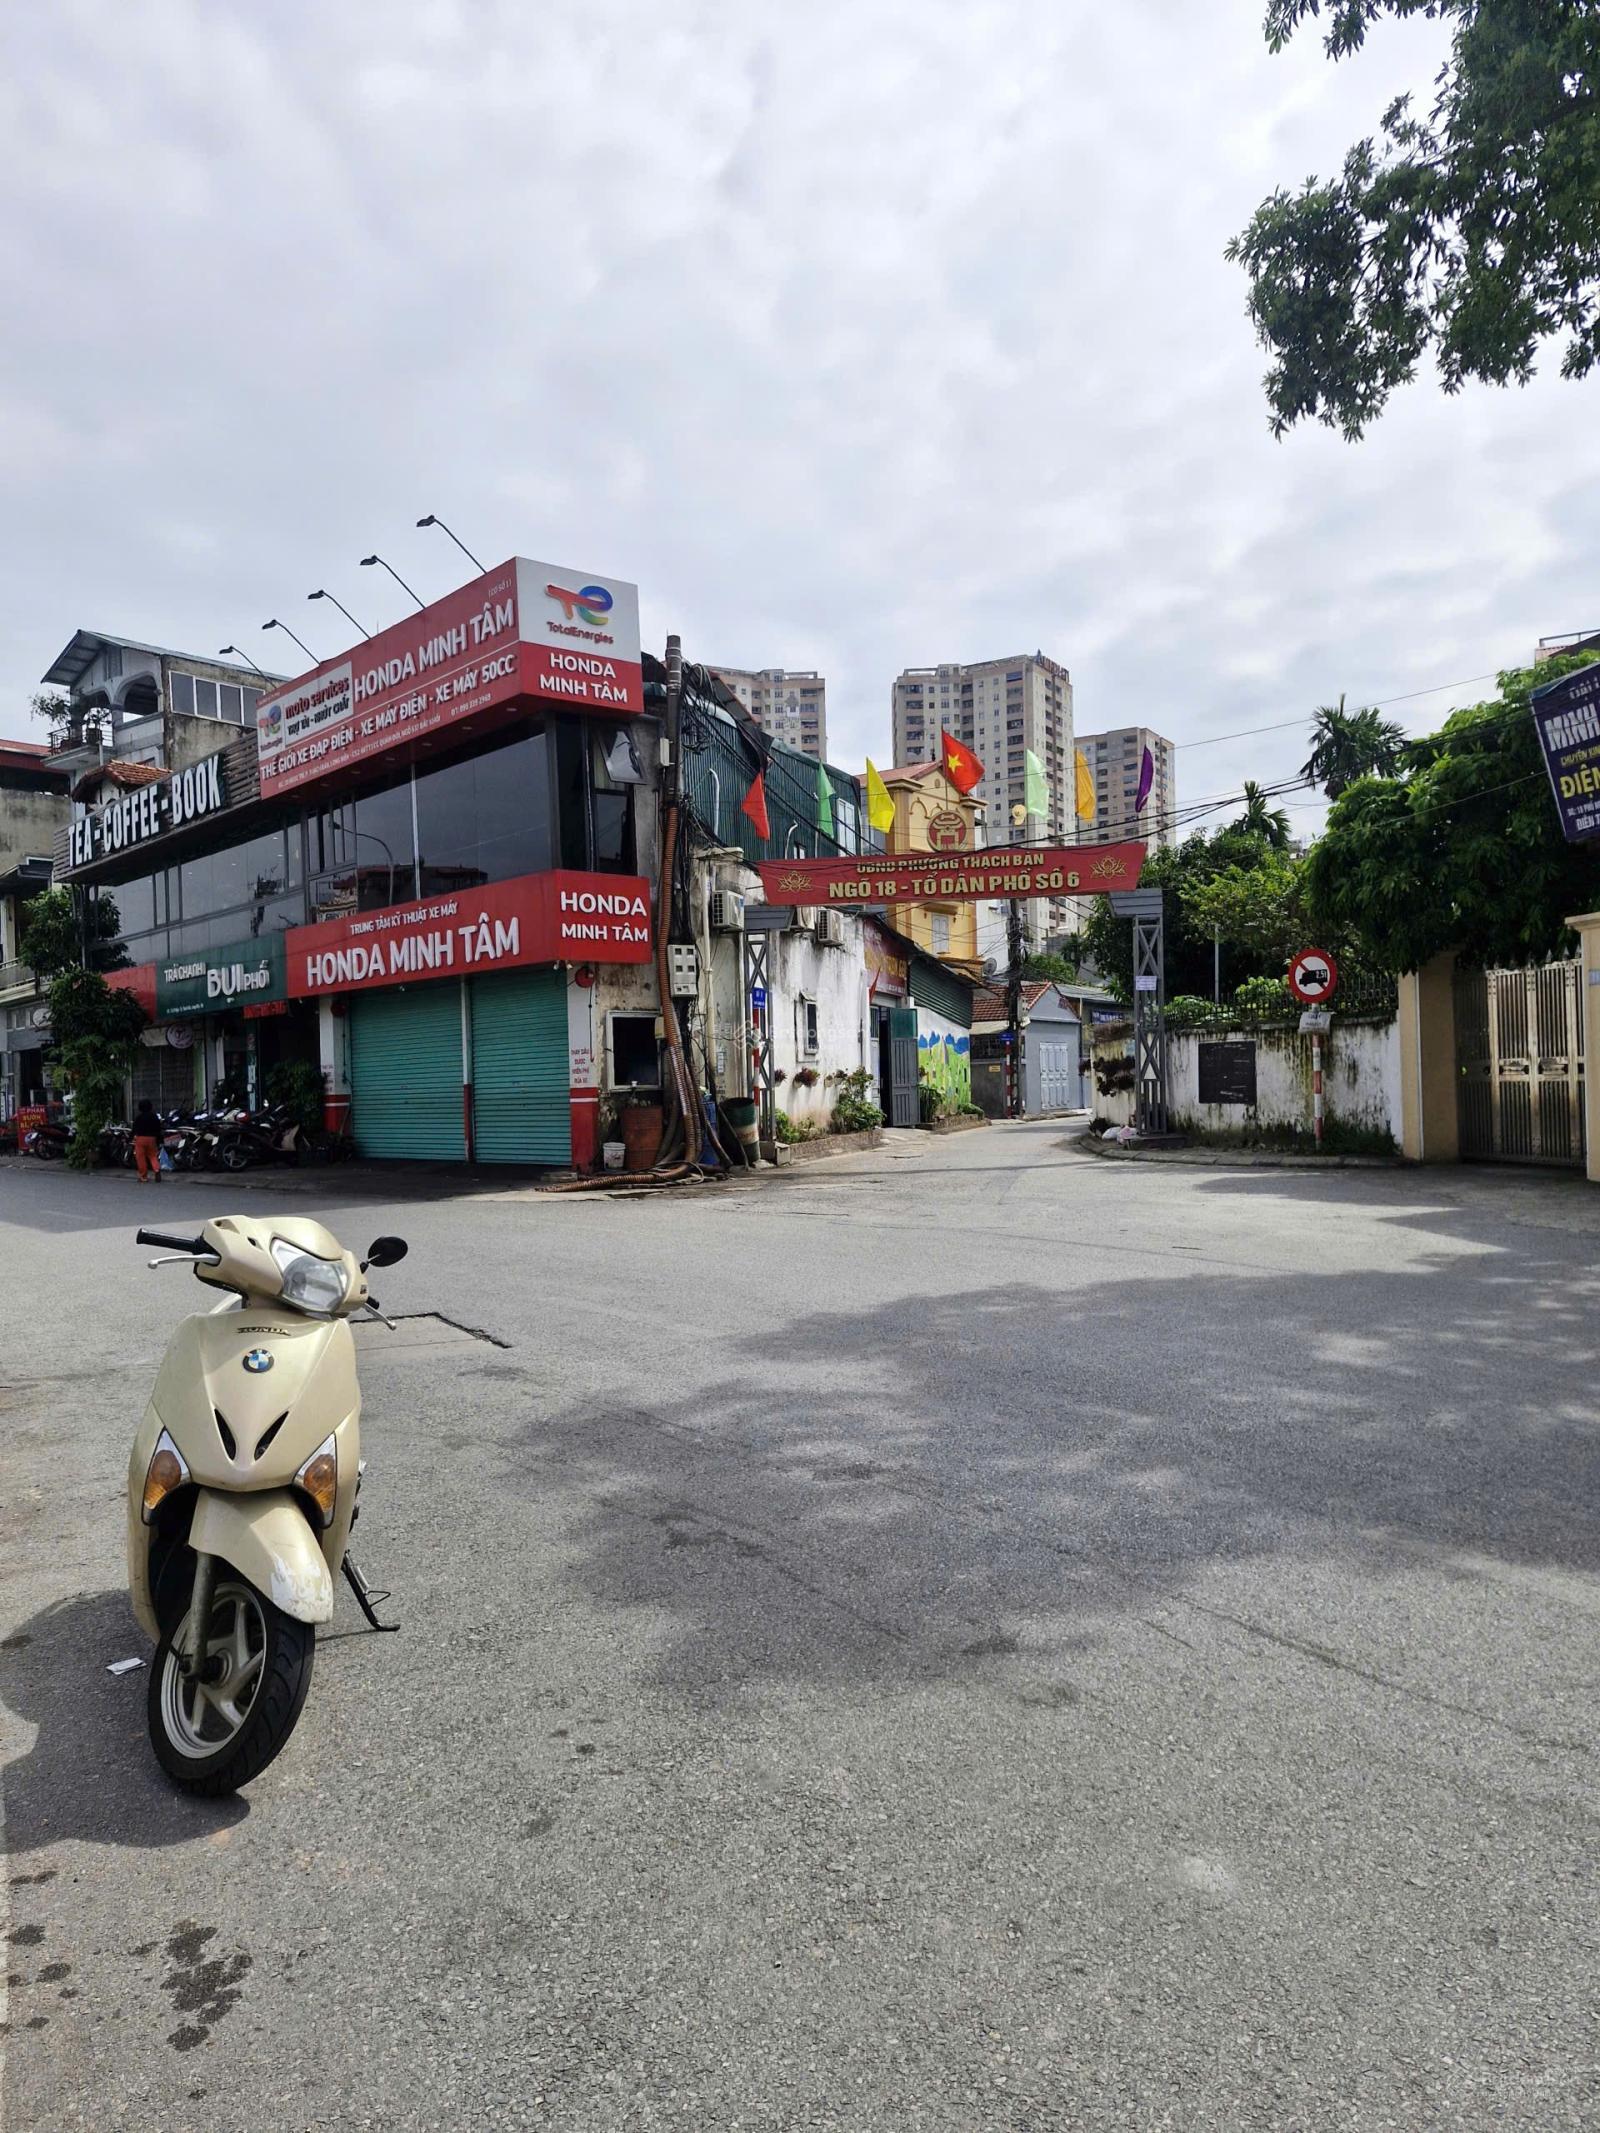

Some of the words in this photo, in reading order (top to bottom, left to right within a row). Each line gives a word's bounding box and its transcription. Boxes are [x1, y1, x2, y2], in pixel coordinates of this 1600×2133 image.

[353, 652, 416, 703] HONDA
[418, 623, 467, 672] MINH
[470, 598, 514, 644] TÂM
[546, 621, 614, 645] TotalEnergies
[550, 652, 616, 679] HONDA
[285, 697, 310, 719] moto
[311, 678, 350, 707] services
[540, 674, 587, 696] MINH
[591, 681, 628, 703] TÂM
[260, 755, 277, 780] THẾ
[278, 750, 296, 773] GIỚI
[296, 748, 308, 764] XE
[309, 739, 329, 760] ĐẠP
[331, 726, 354, 750] ĐIỆN
[361, 718, 374, 737] XE
[375, 704, 398, 731] MÁY
[400, 691, 427, 719] ĐIỆN
[435, 682, 451, 704] XE
[454, 667, 478, 696] MÁY
[481, 654, 515, 684] 50CC
[1544, 703, 1600, 751] MINH
[68, 817, 93, 868] TEA
[103, 784, 159, 851] COFFEE
[171, 754, 221, 825] BOOK
[856, 861, 896, 873] UBND
[962, 855, 1010, 869] THẠCH
[829, 878, 871, 898] NGÕ
[875, 880, 897, 896] 18
[911, 872, 937, 895] TỔ
[940, 873, 985, 894] DÂN
[1067, 871, 1080, 888] 6
[350, 920, 374, 935] TRUNG
[375, 915, 391, 930] TÂM
[391, 911, 401, 927] KỸ
[402, 907, 427, 924] THUẬT
[429, 906, 440, 919] XE
[440, 899, 458, 917] MÁY
[560, 890, 647, 917] HONDA
[306, 943, 385, 987] HONDA
[389, 928, 455, 975] MINH
[458, 912, 520, 963] TÂM
[561, 922, 607, 940] MINH
[611, 922, 649, 942] TÂM
[207, 963, 244, 1004] BỤI
